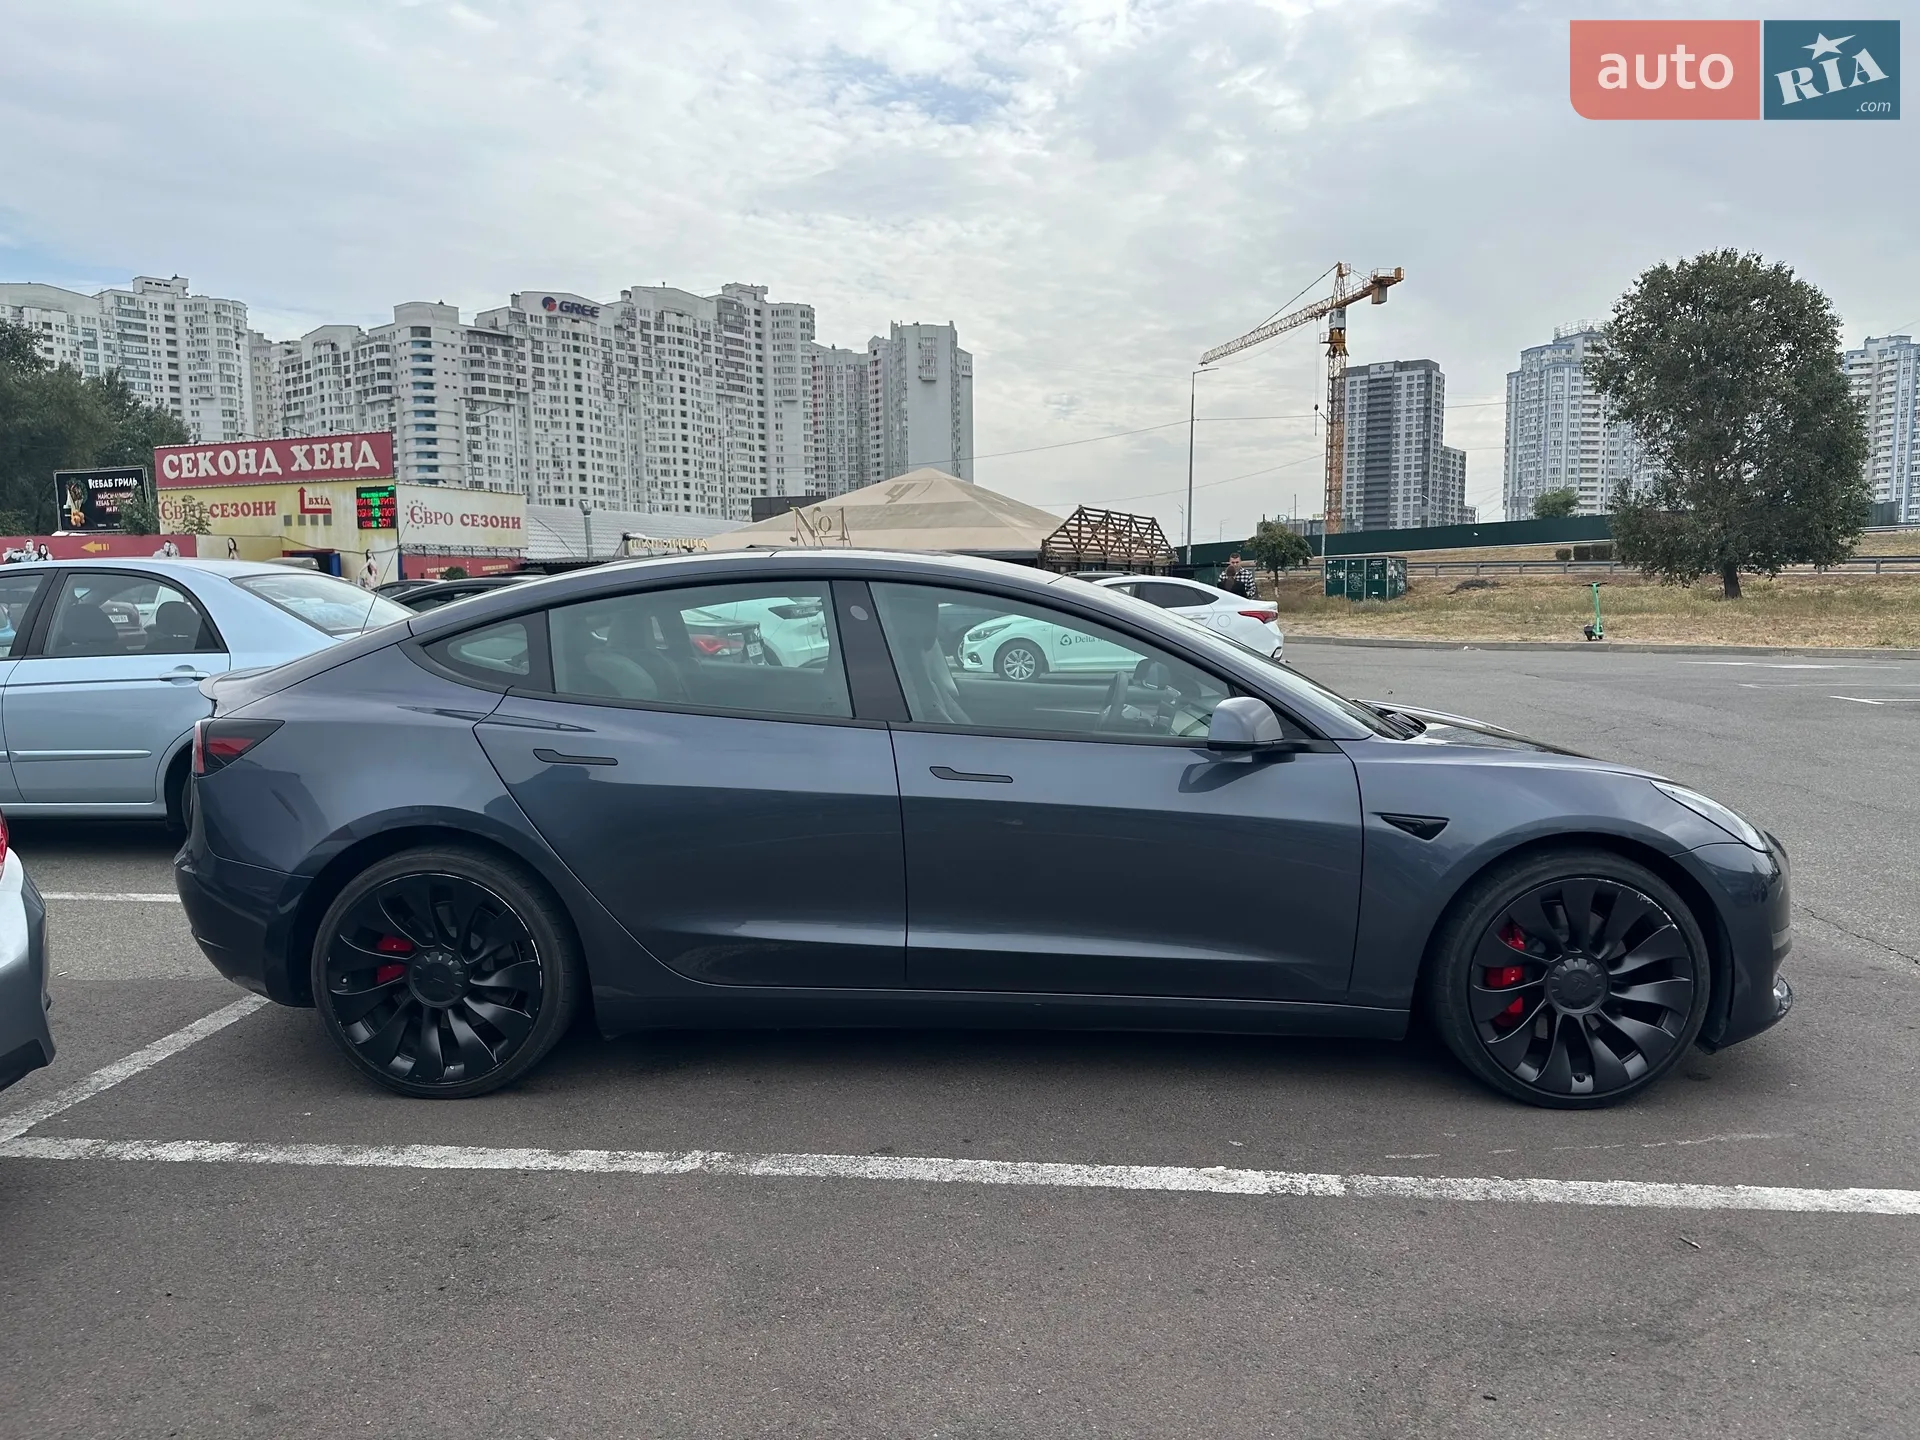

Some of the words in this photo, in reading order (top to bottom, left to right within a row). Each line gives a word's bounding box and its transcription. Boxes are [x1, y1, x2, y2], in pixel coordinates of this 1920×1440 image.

[559, 300, 601, 319] GREE
[162, 447, 283, 479] СЕКОНД
[290, 440, 380, 472] ХЕНД
[88, 479, 113, 489] КЕБАБ
[114, 477, 137, 487] ГРИЛЬ
[209, 501, 277, 519] СЕЗОНИ
[460, 513, 522, 530] СЕЗОНИ
[1075, 636, 1096, 644] Delta
